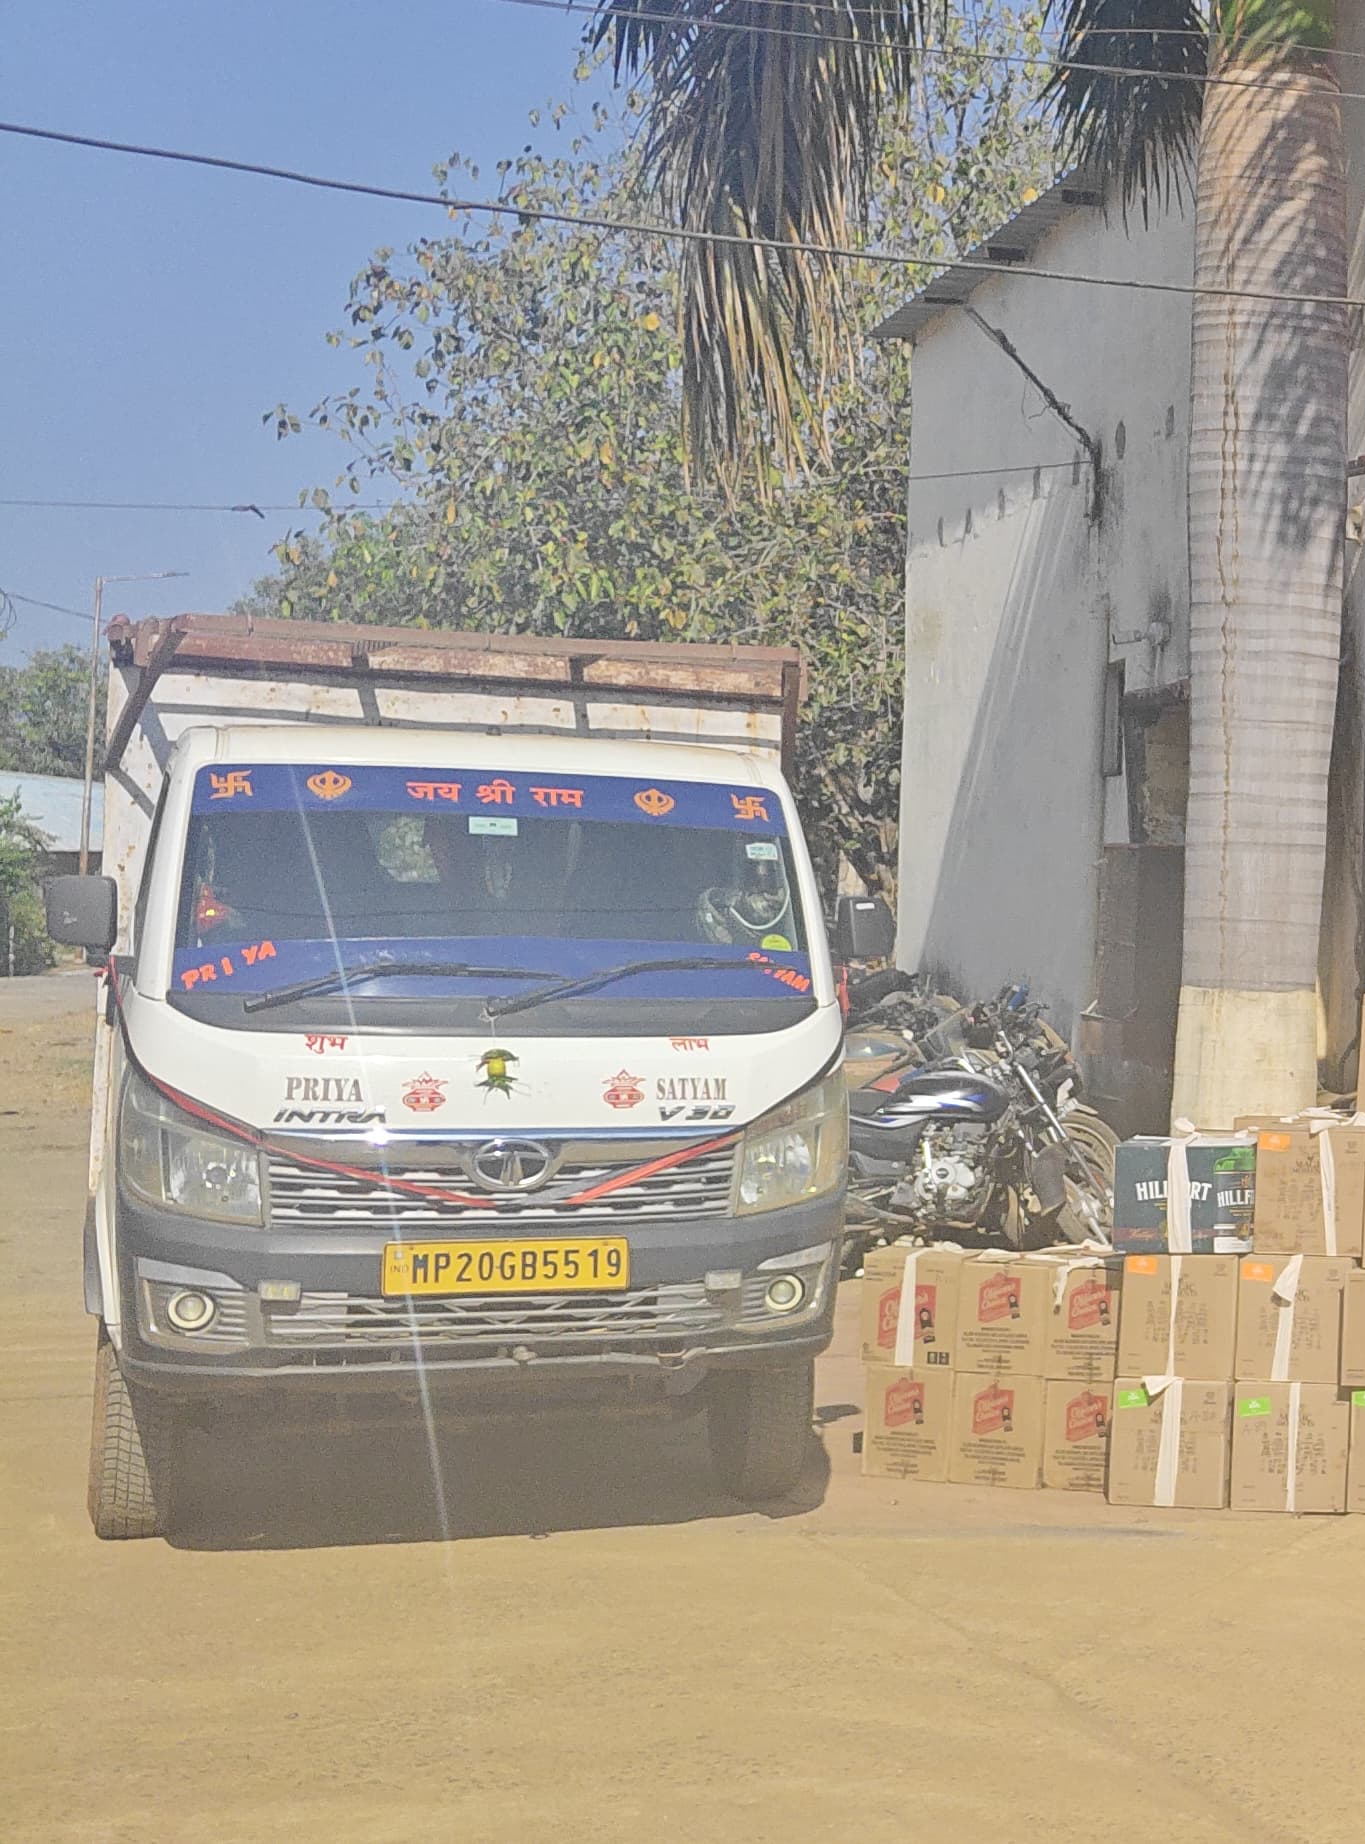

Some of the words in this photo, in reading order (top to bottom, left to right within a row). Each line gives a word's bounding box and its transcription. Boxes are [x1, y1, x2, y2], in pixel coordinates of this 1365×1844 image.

[406, 782, 462, 803] जय
[476, 779, 516, 805] श्री
[529, 787, 585, 809] राम
[304, 1033, 348, 1054] शुभ
[669, 1036, 709, 1051] लाभ
[284, 1077, 364, 1102] PRIYA
[656, 1077, 727, 1100] SATYAM
[273, 1107, 387, 1124] INTRA
[1135, 1181, 1212, 1201] HILLRT
[412, 1248, 621, 1283] MP20GB5519
